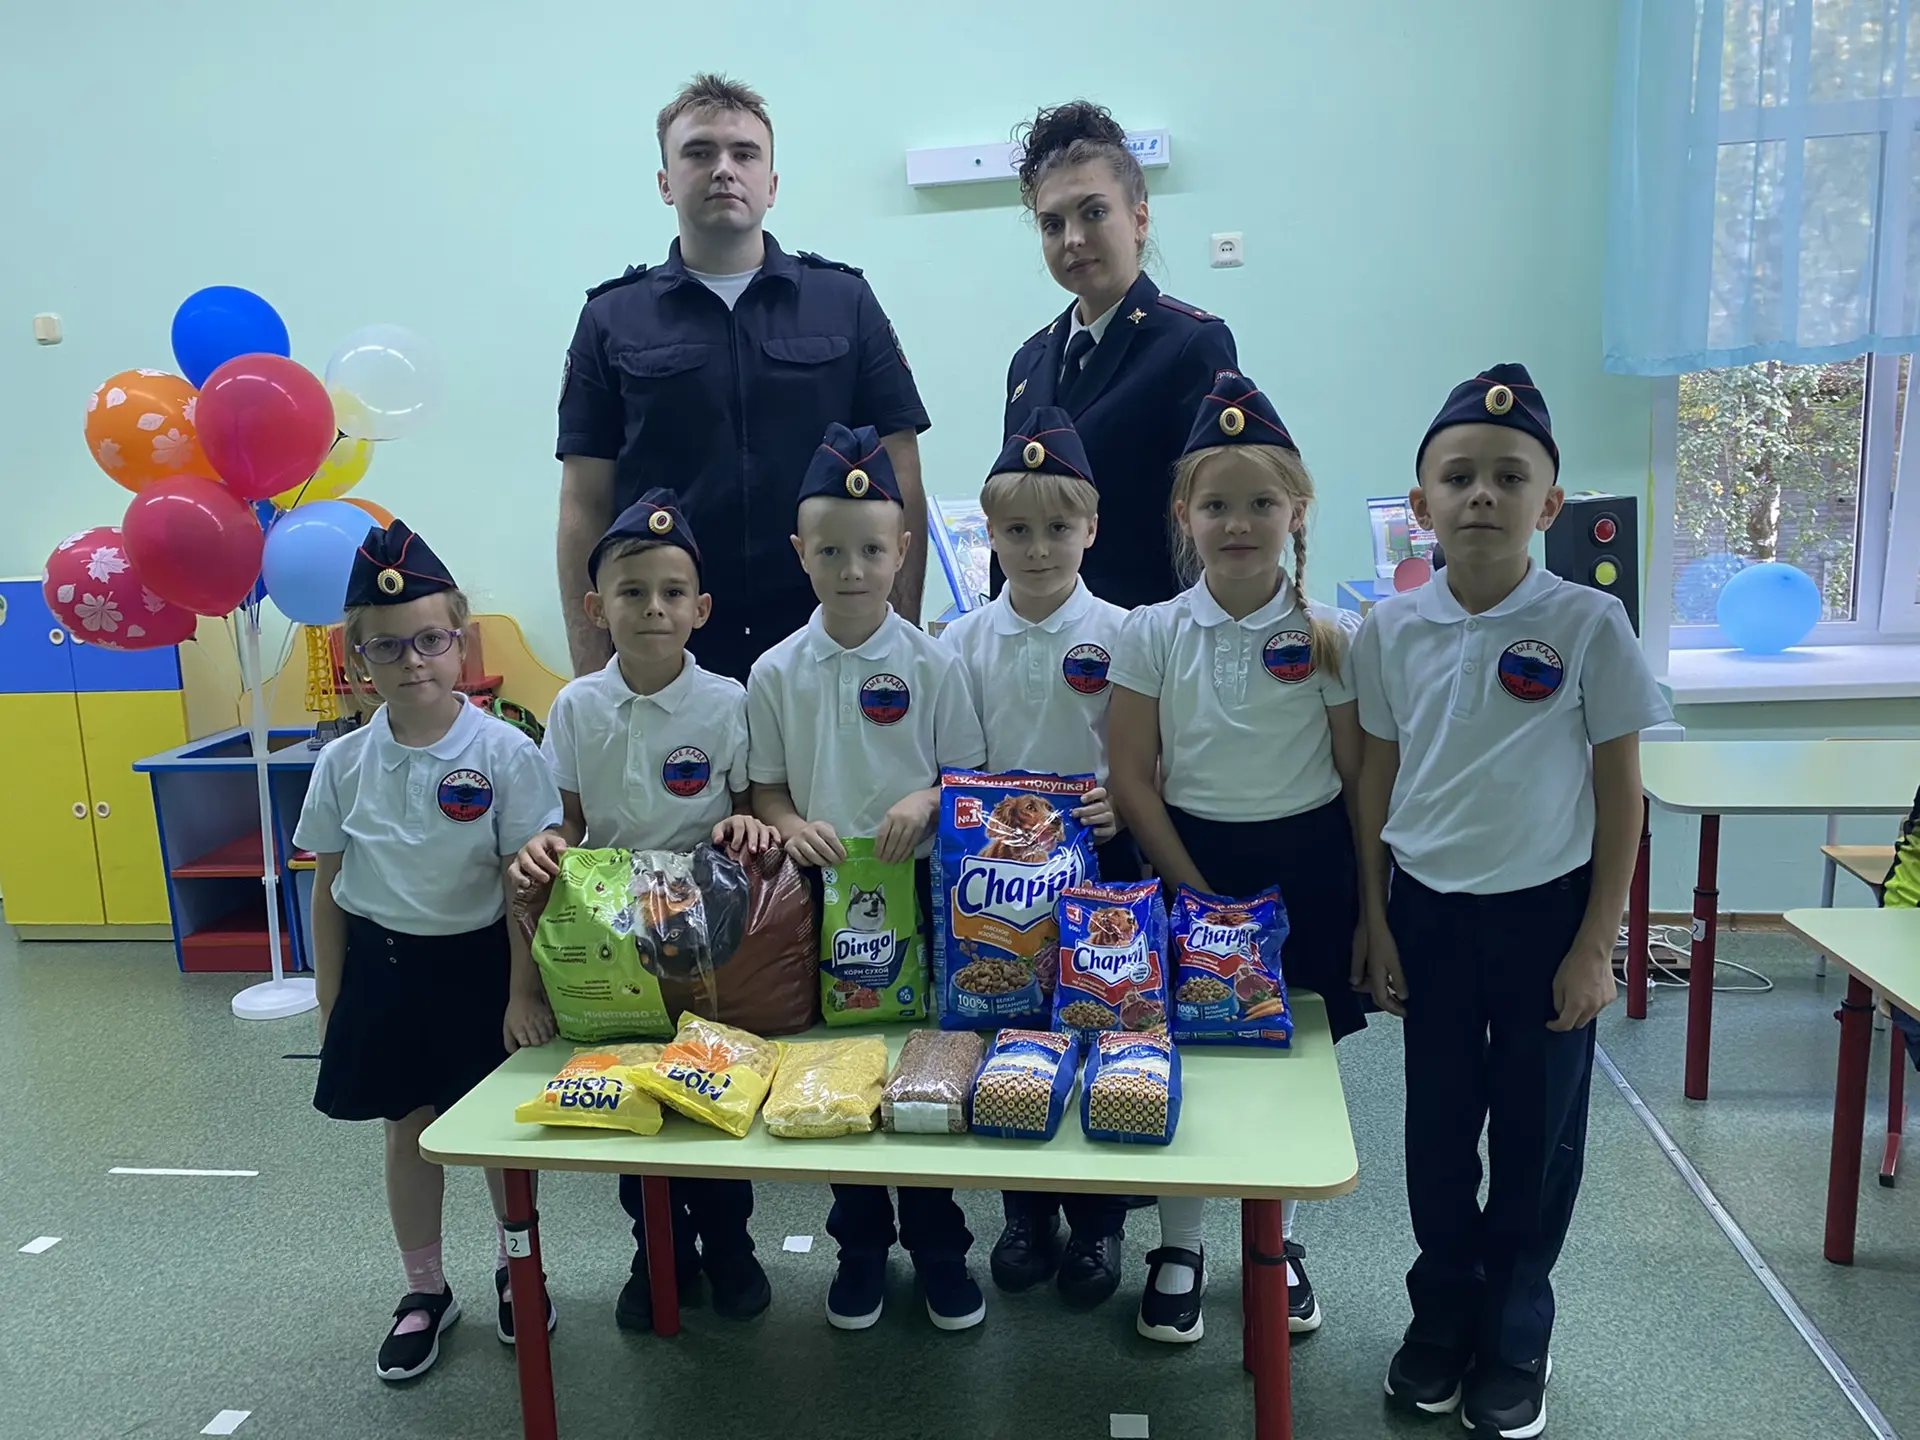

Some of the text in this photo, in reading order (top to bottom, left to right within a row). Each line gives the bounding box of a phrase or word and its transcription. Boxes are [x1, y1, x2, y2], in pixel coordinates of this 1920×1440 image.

[957, 858, 1077, 915] Chappi
[837, 934, 891, 961] Dingo
[1186, 926, 1256, 949] Chappi
[1072, 941, 1144, 975] Chappi
[864, 966, 889, 976] СУХОЙ
[958, 993, 989, 1010] 100%
[1177, 1003, 1199, 1015] 100%
[509, 1237, 520, 1253] 2
